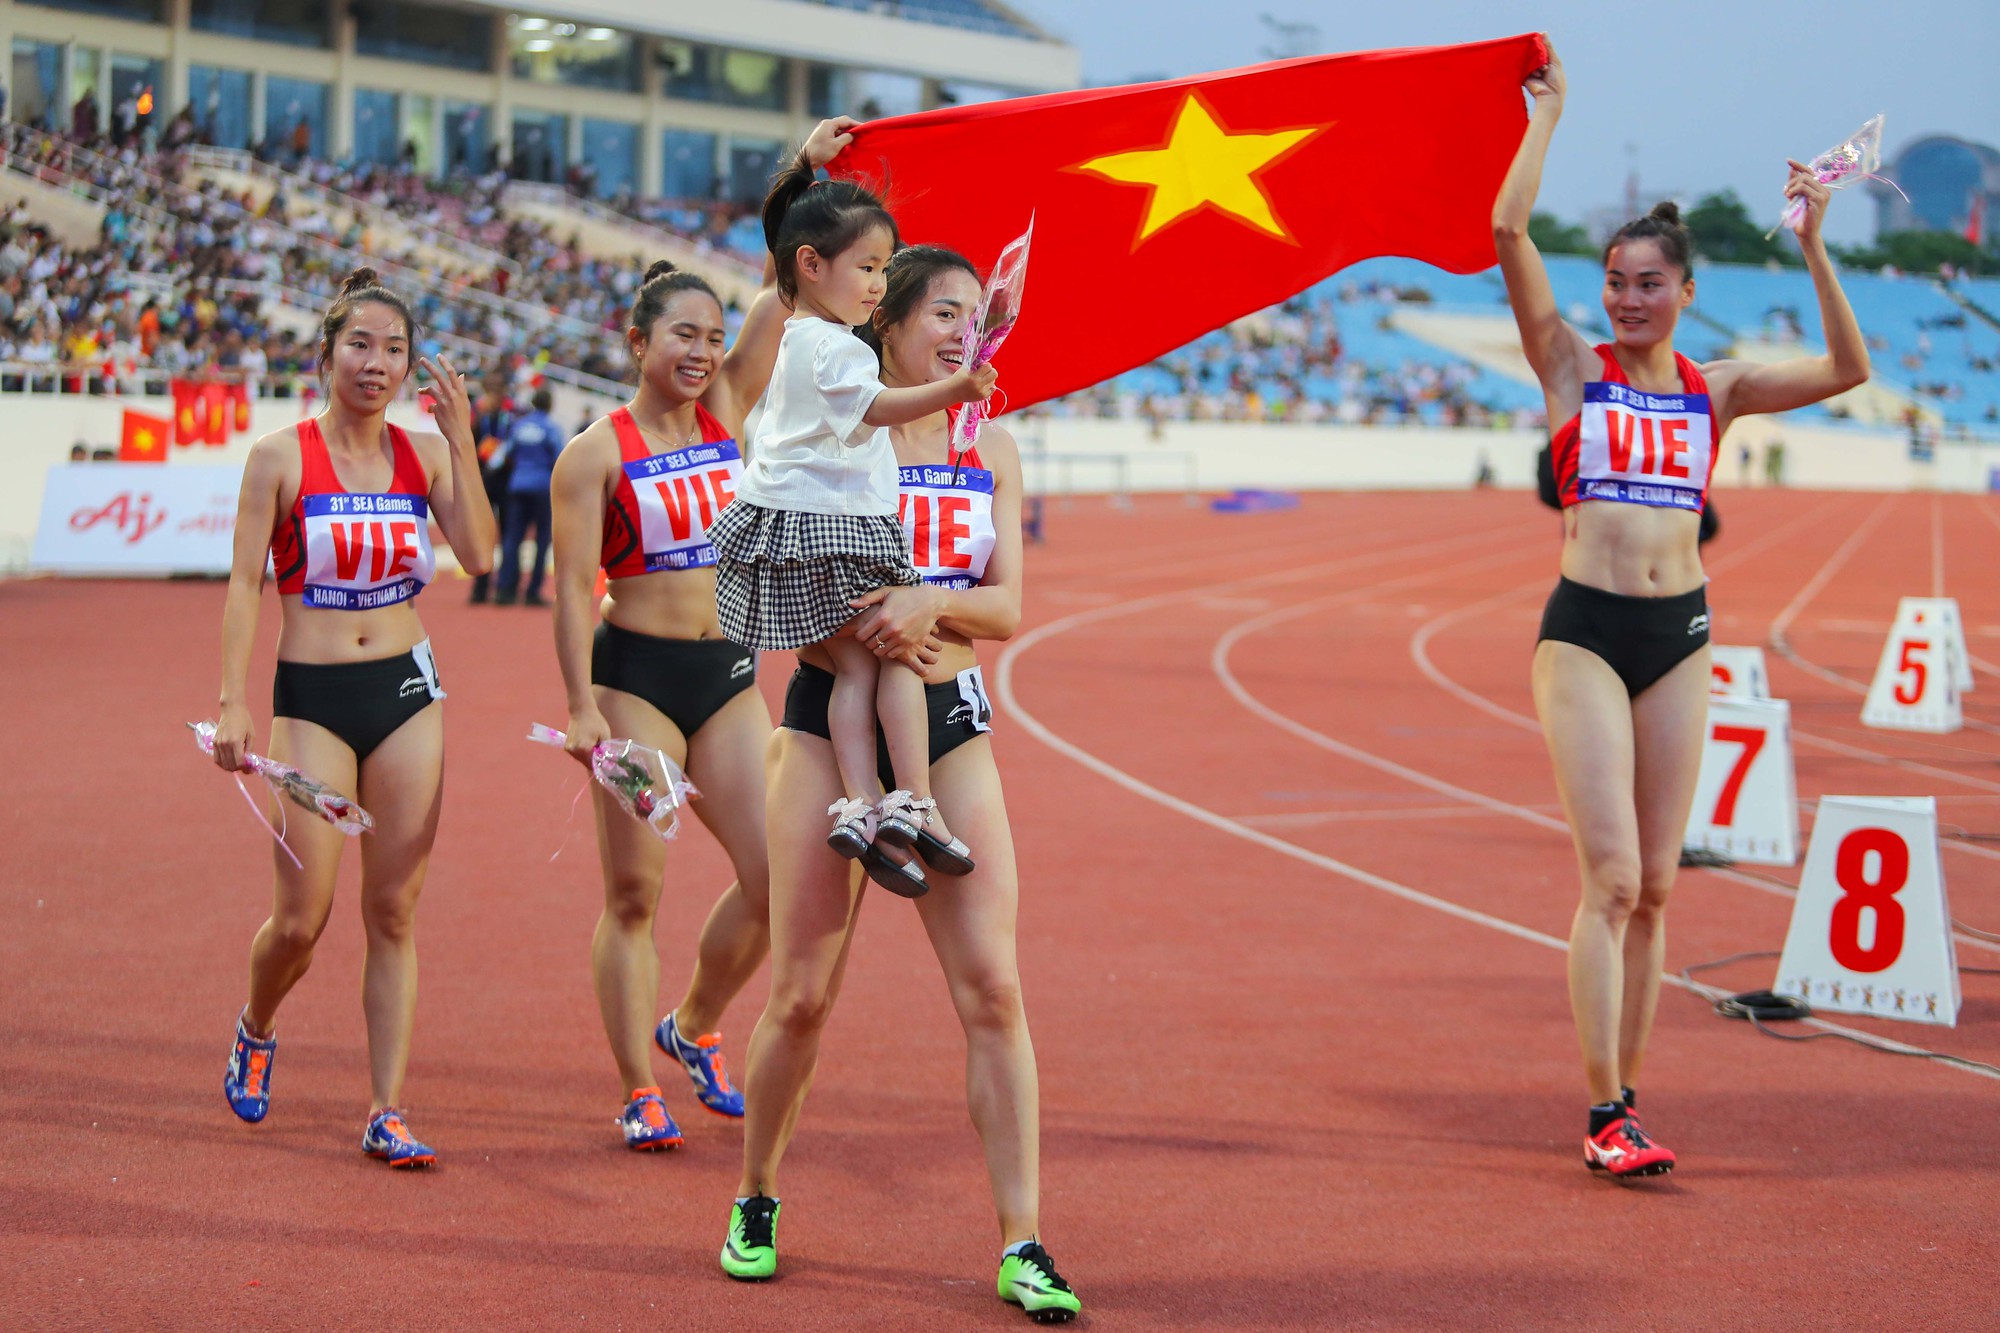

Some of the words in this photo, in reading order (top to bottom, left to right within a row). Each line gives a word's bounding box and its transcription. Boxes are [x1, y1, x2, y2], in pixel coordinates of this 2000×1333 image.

[1646, 396, 1686, 410] Games
[665, 453, 689, 469] SEA
[688, 448, 720, 464] Games
[1606, 409, 1689, 479] VIE
[352, 496, 374, 512] SEA
[376, 496, 413, 512] Games
[897, 494, 973, 569] IE
[330, 522, 418, 582] VIE
[655, 551, 688, 567] HANOI
[314, 588, 347, 607] HANOI
[357, 586, 398, 607] VIETNAM
[1894, 640, 1929, 705] 5
[1710, 724, 1767, 827] 7
[1829, 826, 1910, 974] 8
